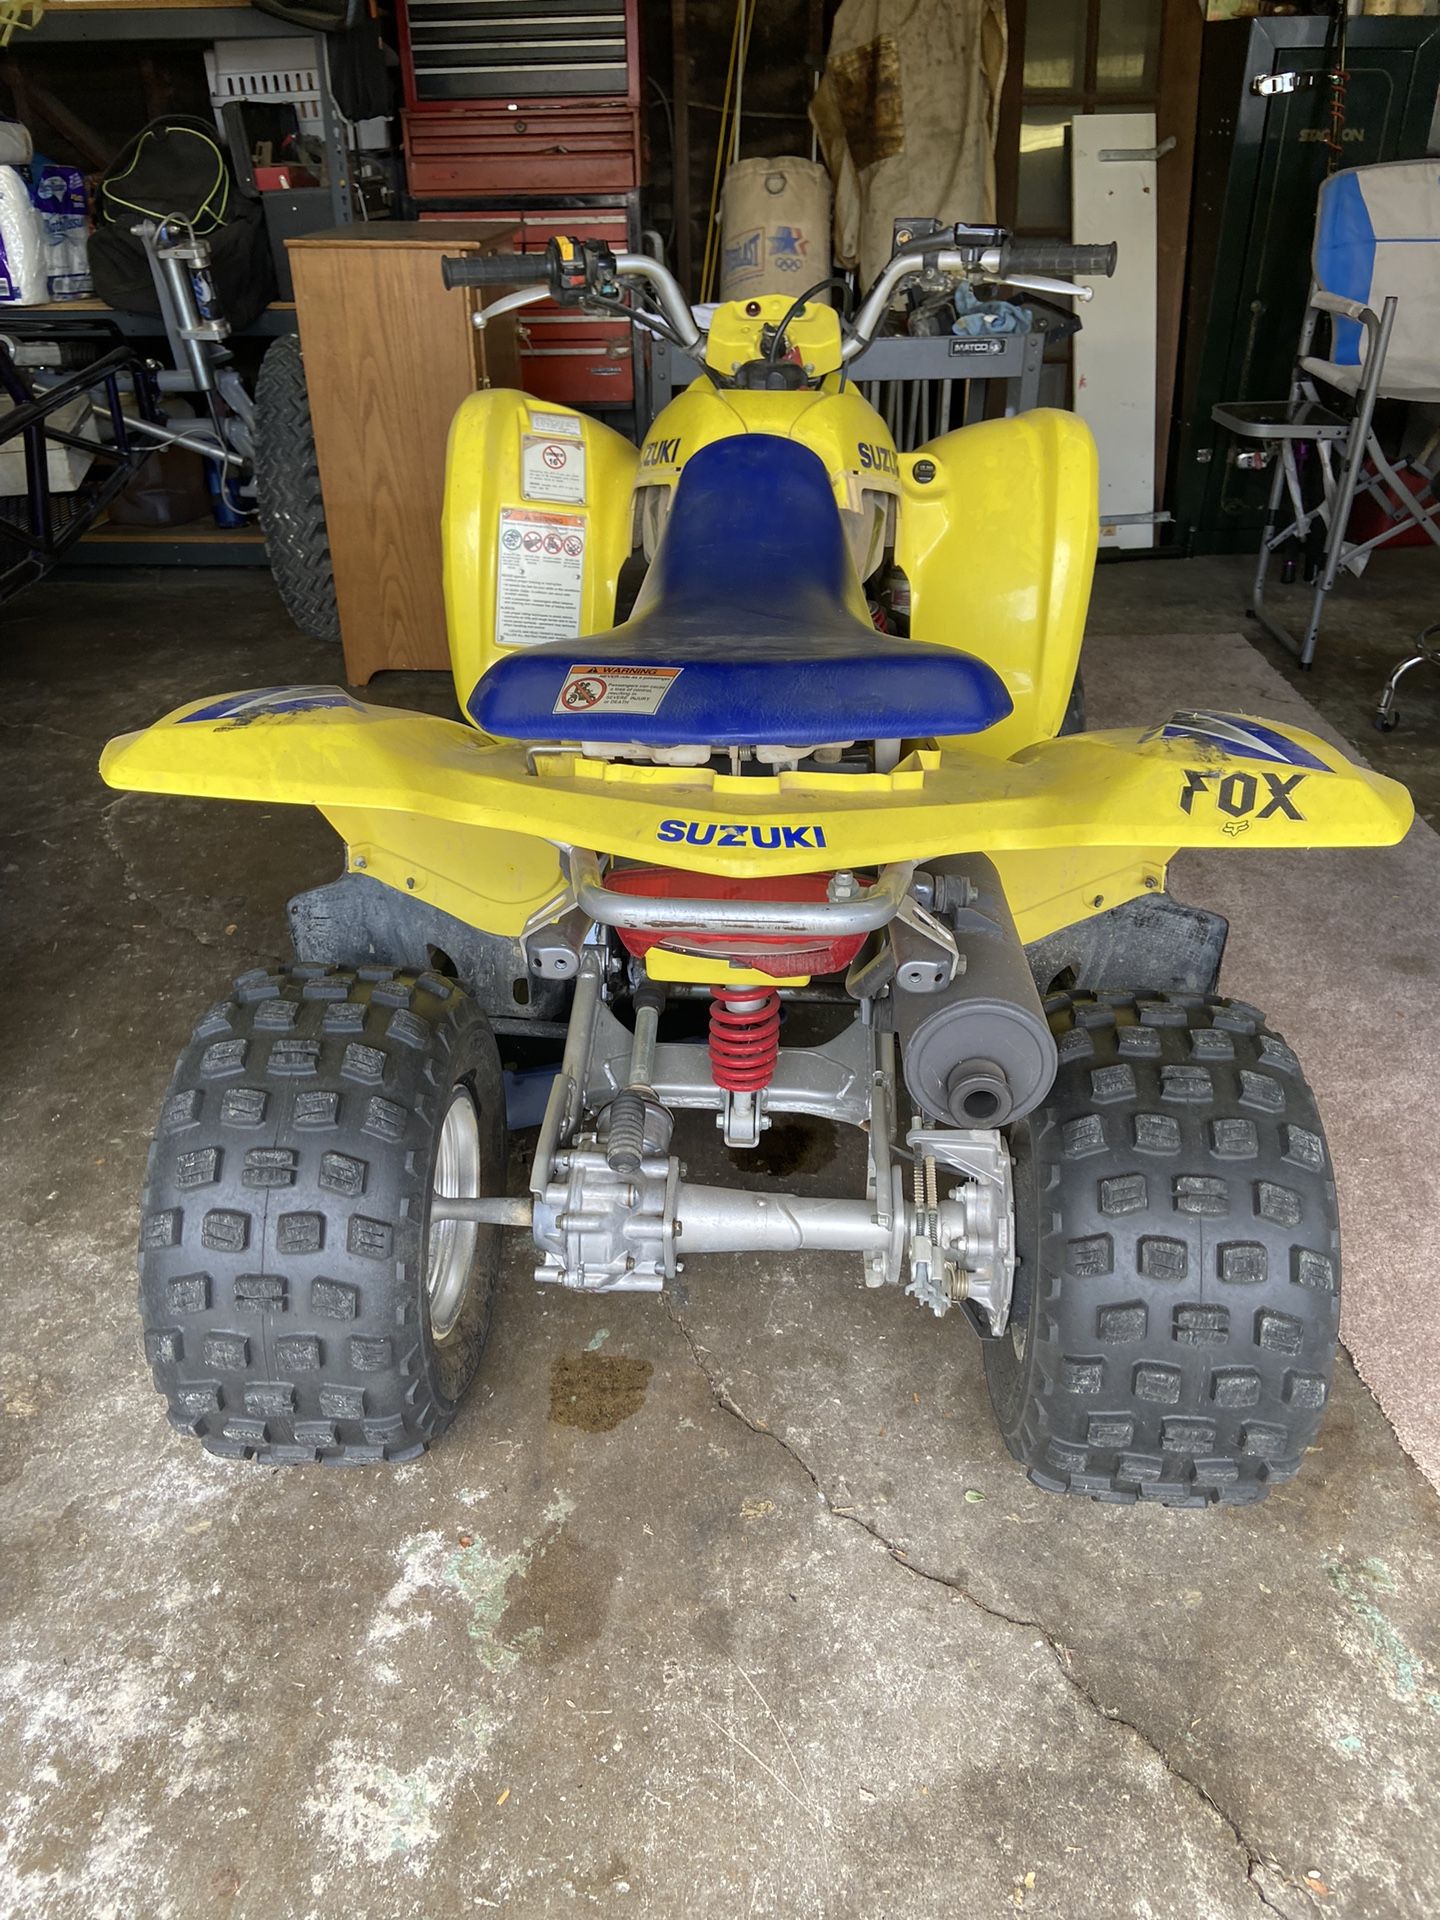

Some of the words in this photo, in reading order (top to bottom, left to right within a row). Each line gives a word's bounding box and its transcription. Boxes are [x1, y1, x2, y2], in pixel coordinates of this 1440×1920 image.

[954, 343, 988, 351] MATCO
[549, 458, 558, 466] 16
[643, 438, 681, 466] ZUKI
[858, 442, 899, 478] SUZU
[603, 667, 657, 676] WARNING
[1180, 770, 1307, 821] FOX
[657, 820, 827, 849] SUZUKI
